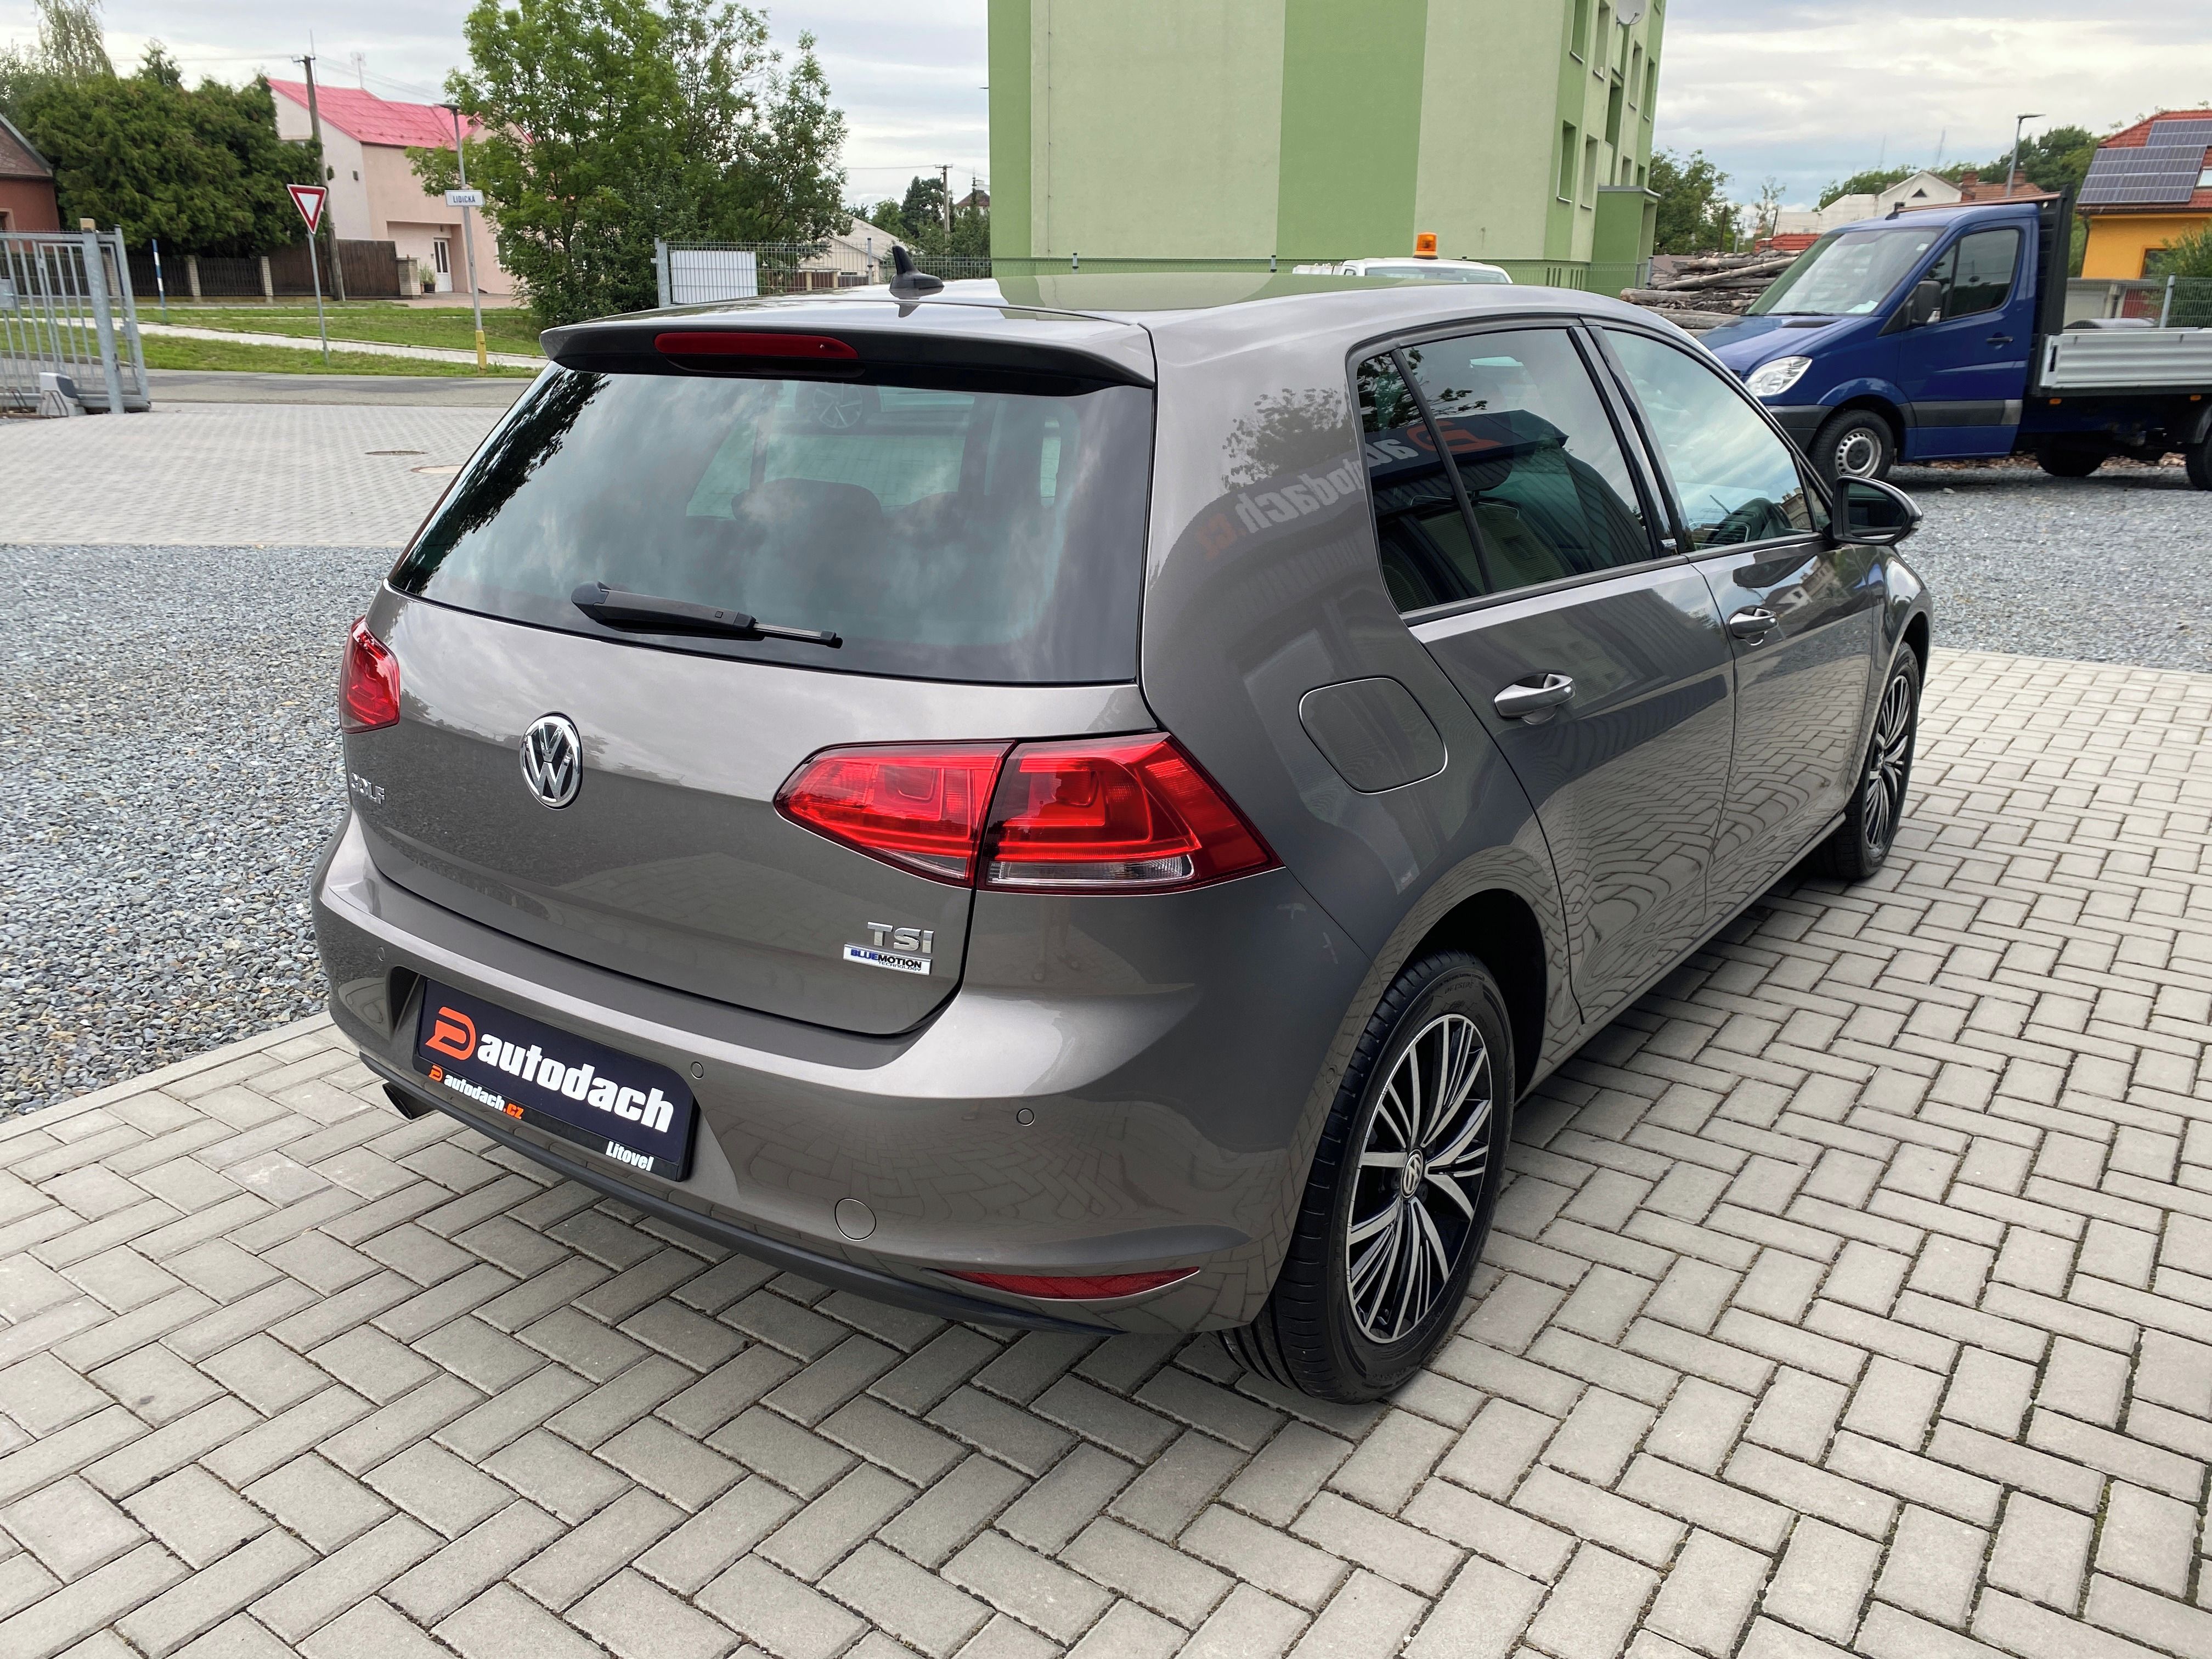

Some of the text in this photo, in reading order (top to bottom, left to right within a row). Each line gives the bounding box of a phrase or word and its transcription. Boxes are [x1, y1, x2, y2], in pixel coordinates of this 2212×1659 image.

[453, 194, 476, 203] LIDICKÁ
[867, 922, 934, 954] TSI
[850, 949, 922, 968] BLUEMOTION
[878, 961, 922, 972] TECHNOLOGY
[444, 1074, 524, 1120] autodach.cz
[477, 1034, 675, 1133] autodach
[605, 1141, 655, 1171] Litovel
